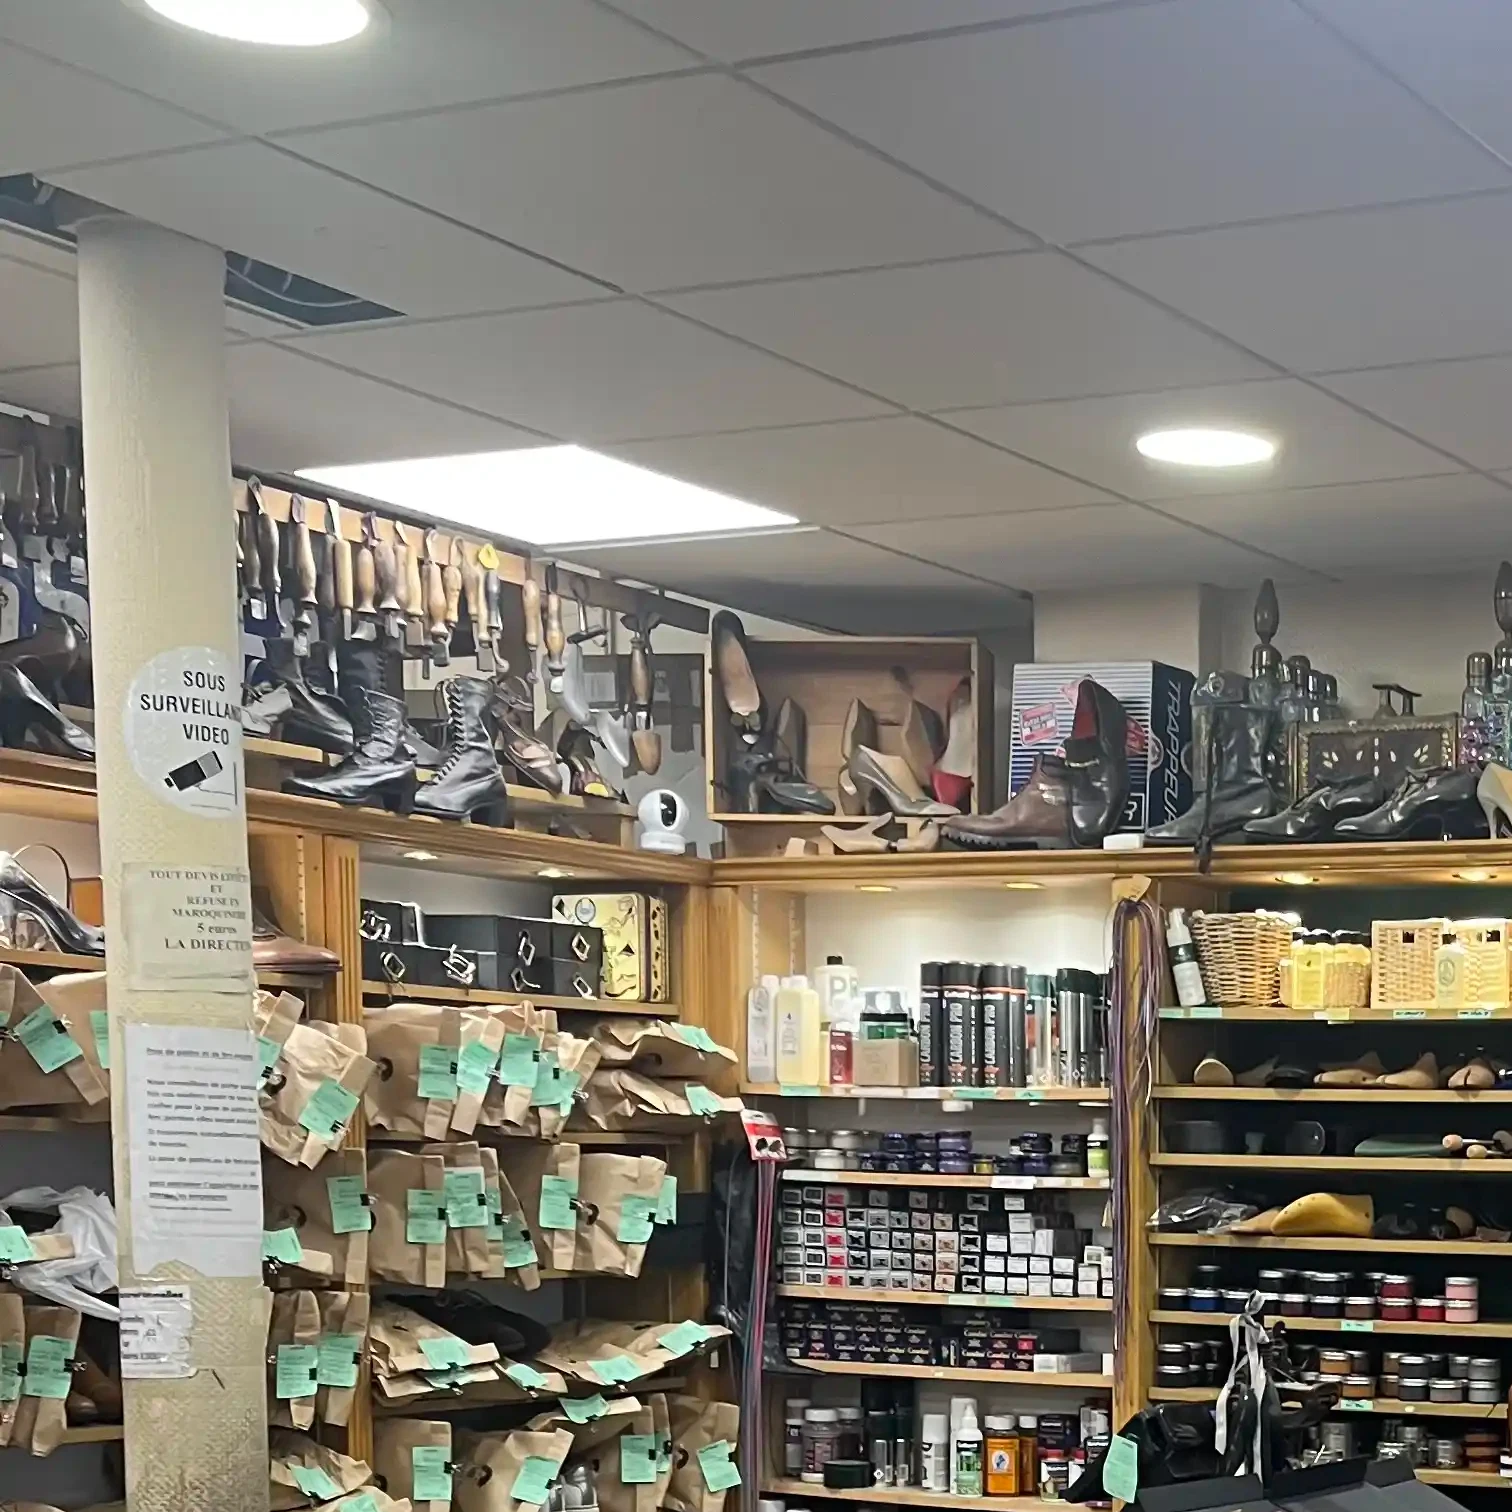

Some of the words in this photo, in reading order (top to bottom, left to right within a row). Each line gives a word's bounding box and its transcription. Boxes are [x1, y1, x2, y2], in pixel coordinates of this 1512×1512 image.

[183, 670, 226, 692] SOUS
[182, 723, 230, 746] VIDEO
[150, 870, 181, 880] TOUT
[185, 871, 219, 881] DEVIS
[197, 922, 205, 933] 5
[164, 938, 186, 950] LA
